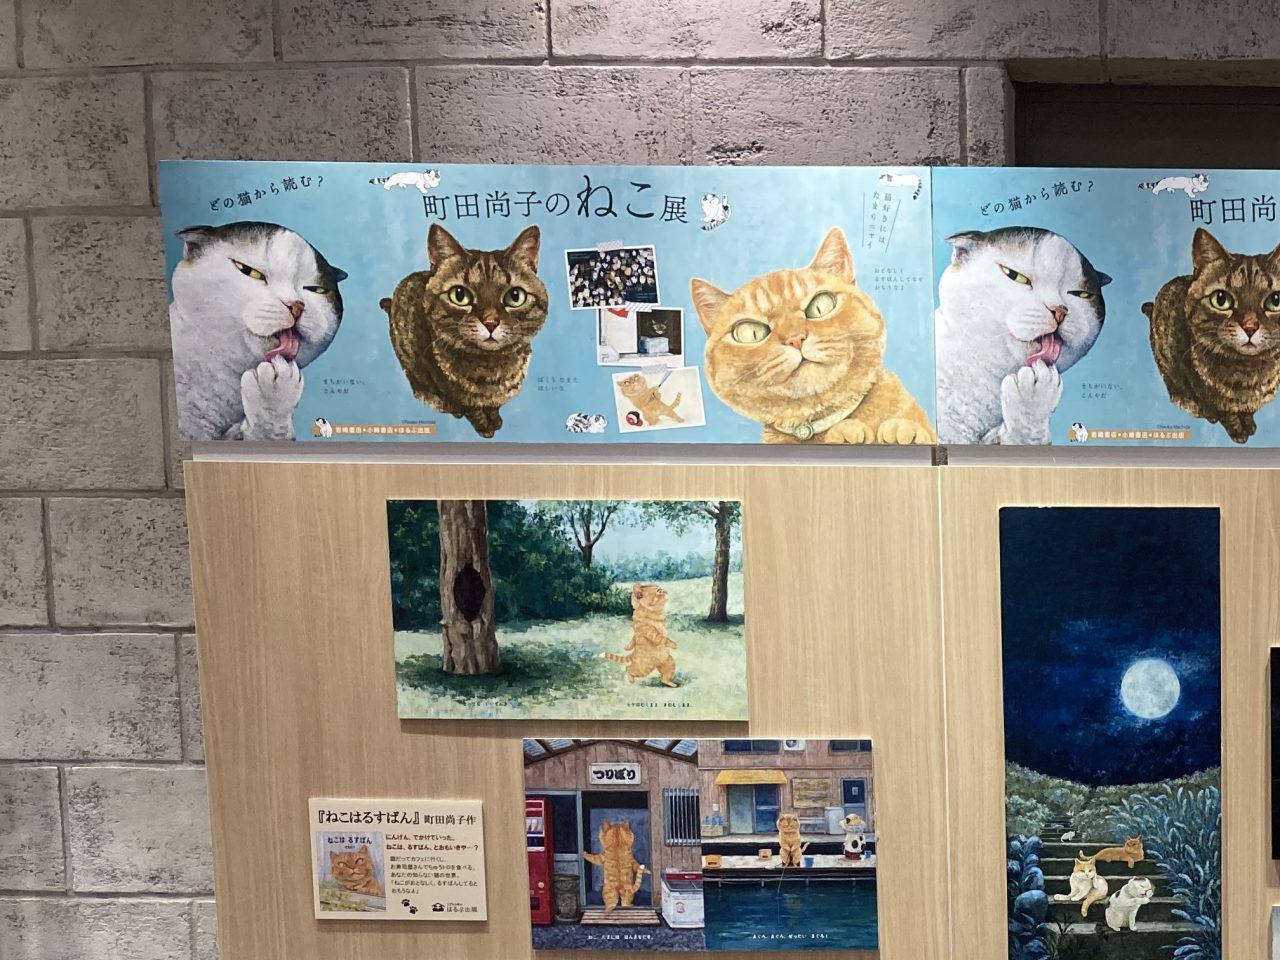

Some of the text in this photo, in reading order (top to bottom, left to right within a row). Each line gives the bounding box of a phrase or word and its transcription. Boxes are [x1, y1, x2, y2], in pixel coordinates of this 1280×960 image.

[209, 175, 324, 211] どの猫から読む？
[424, 175, 689, 224] 町田尚子のねこ展
[981, 180, 1095, 217] どの猫から読む？
[593, 768, 636, 780] つりぼり
[318, 810, 477, 825] 『ねこはるすばん』 町田尚子作
